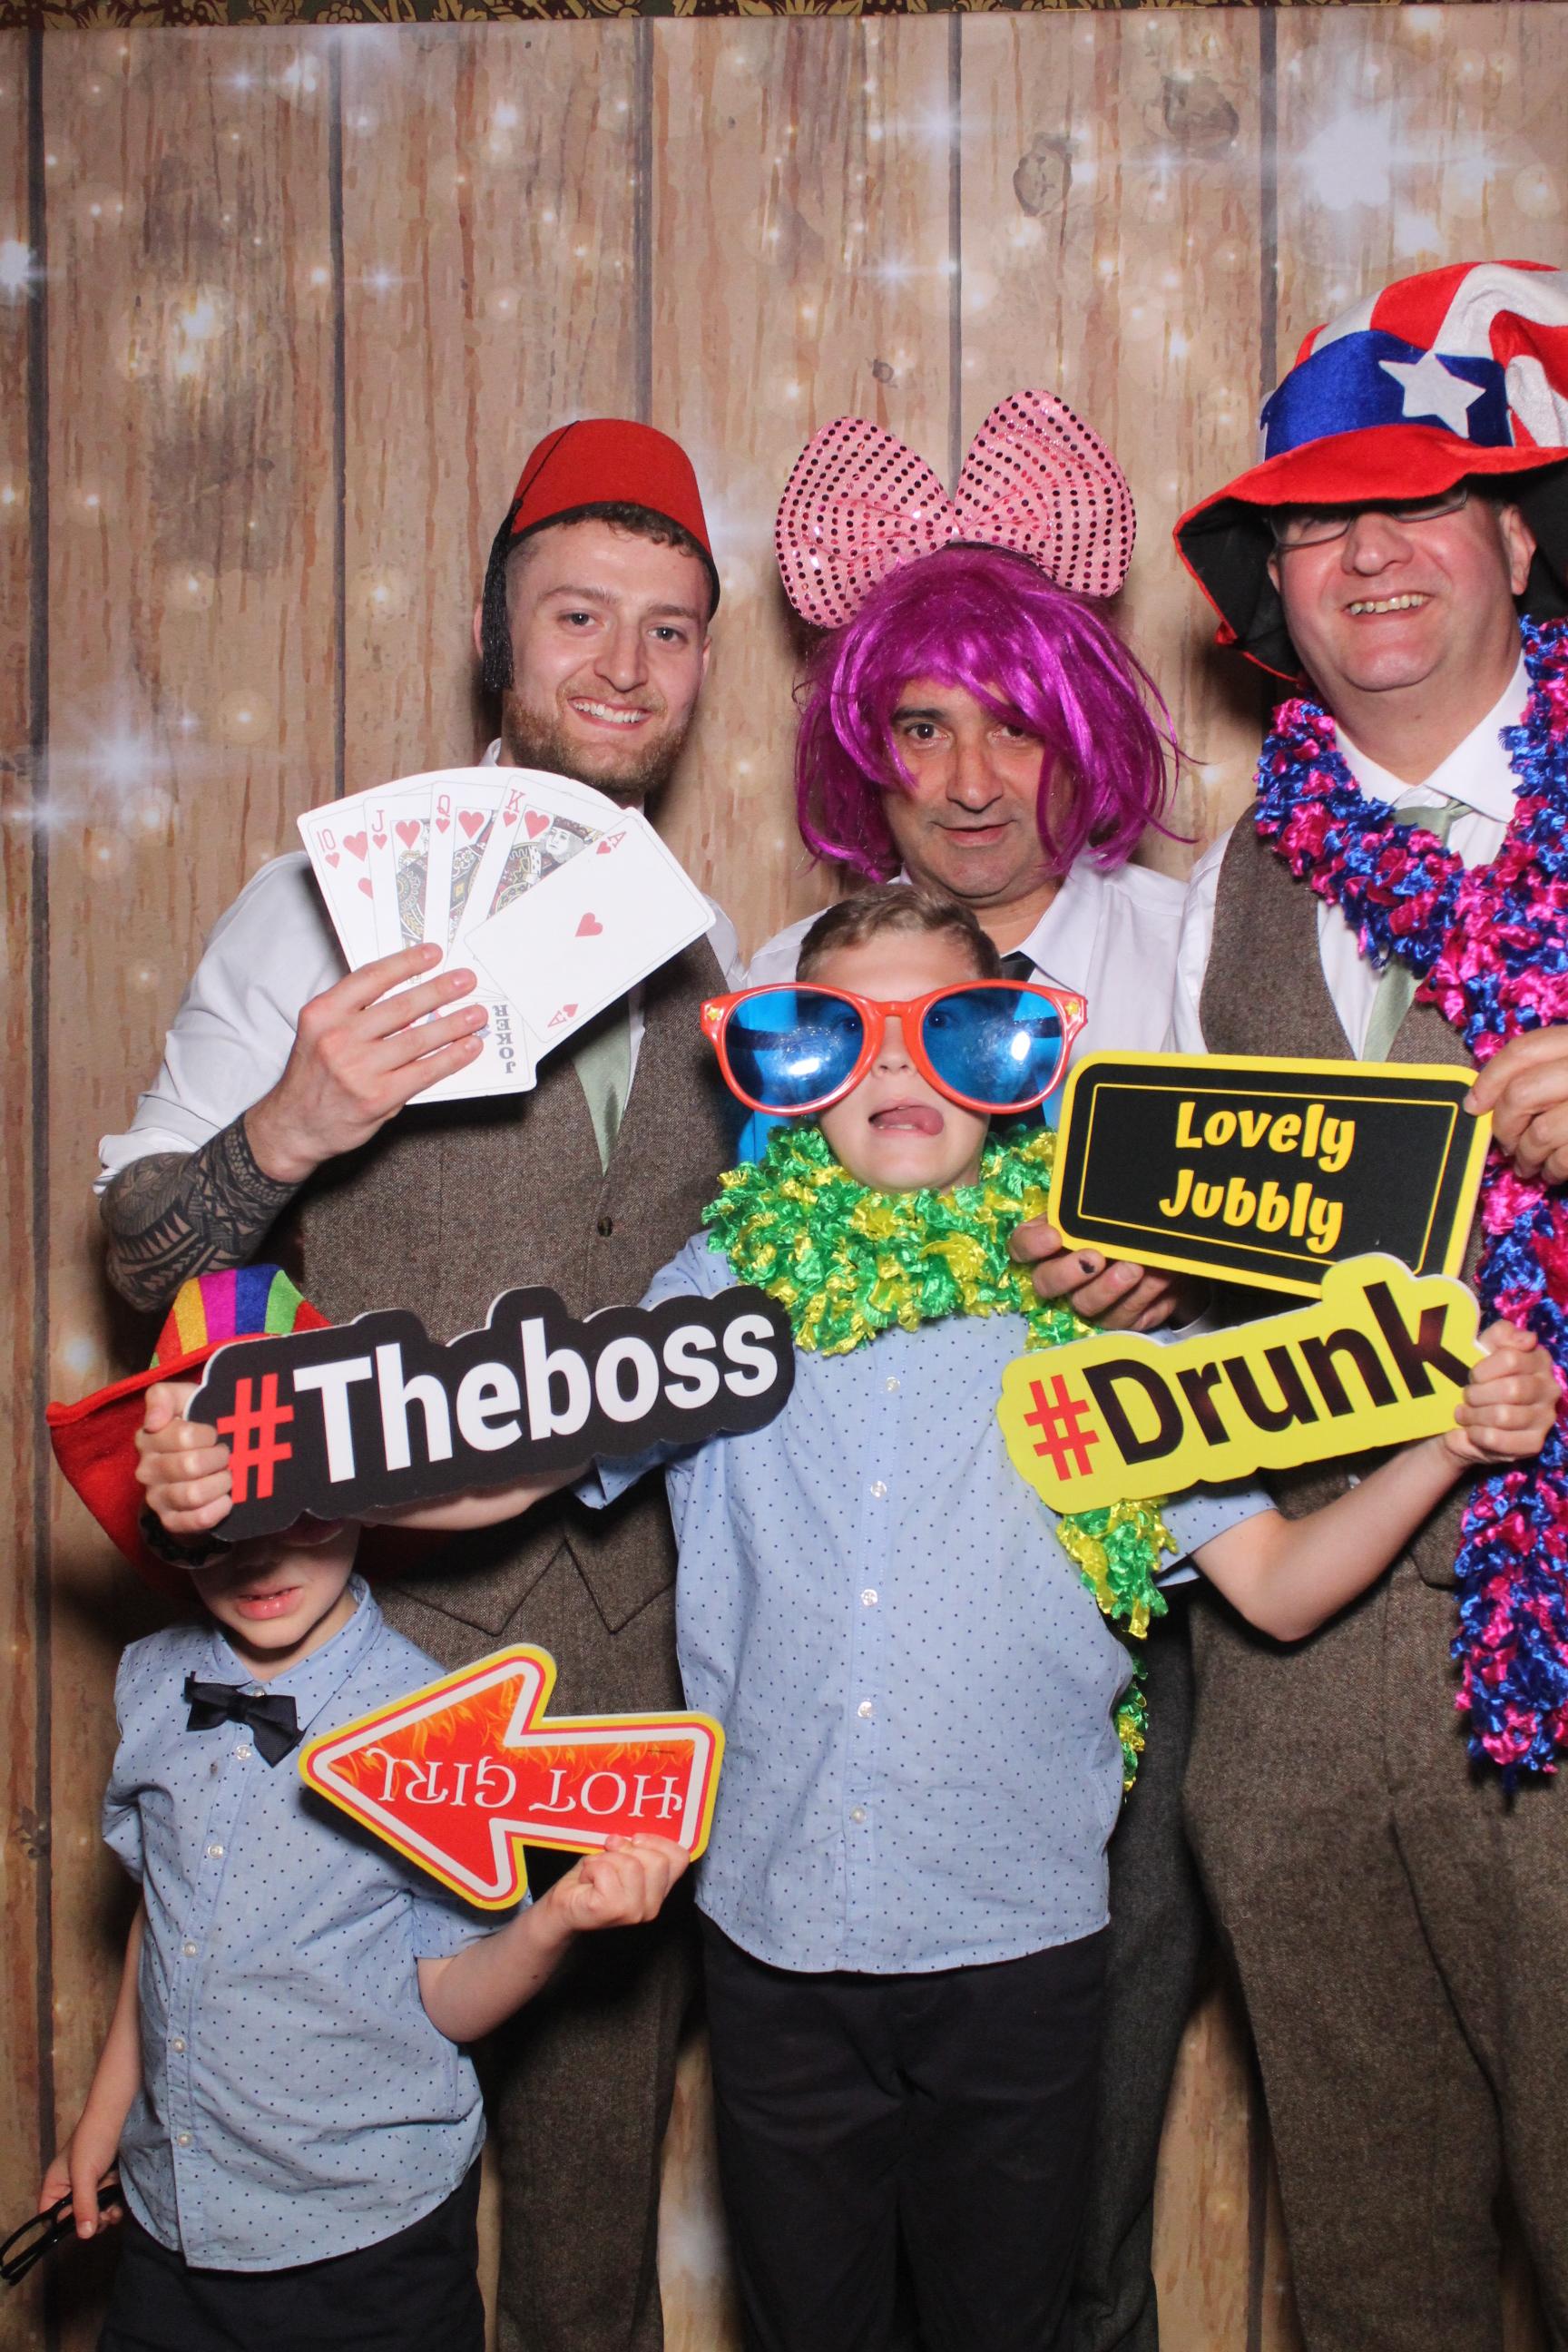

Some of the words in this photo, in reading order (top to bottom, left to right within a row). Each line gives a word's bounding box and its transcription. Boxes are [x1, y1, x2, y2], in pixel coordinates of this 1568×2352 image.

[371, 809, 385, 833] J
[436, 794, 451, 818] Q
[505, 789, 525, 813] K
[317, 828, 336, 853] 10
[607, 831, 627, 848] A
[492, 1004, 516, 1074] JOKER
[547, 1010, 567, 1028] A
[1175, 1101, 1356, 1172] Lovely
[1158, 1169, 1343, 1254] Jubbly
[1024, 1280, 1472, 1481] #Drunk
[217, 1314, 779, 1504] #Theboss
[365, 1747, 517, 1808] GIRL
[529, 1769, 683, 1819] HOT
